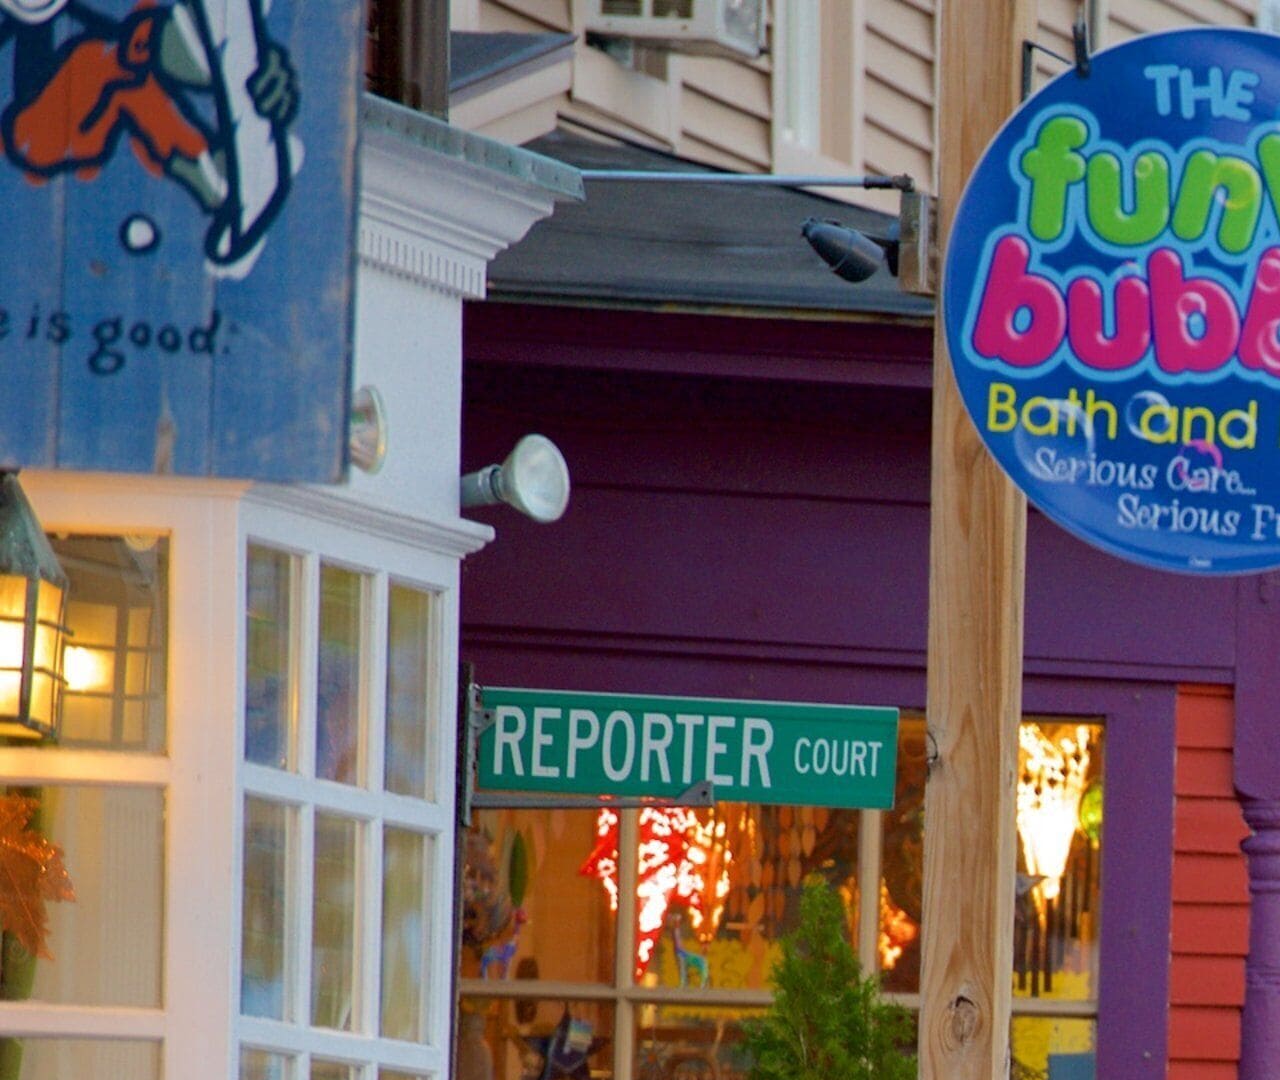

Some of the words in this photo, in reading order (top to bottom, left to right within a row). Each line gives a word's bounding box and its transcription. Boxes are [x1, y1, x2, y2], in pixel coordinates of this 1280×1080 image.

[1143, 63, 1261, 122] THE
[27, 302, 70, 345] is
[986, 382, 1118, 440] Bath
[1139, 399, 1259, 450] and
[1034, 446, 1157, 491] Serious
[1116, 493, 1241, 536] Serious
[492, 704, 775, 789] REPORTER
[793, 737, 883, 778] COURT
